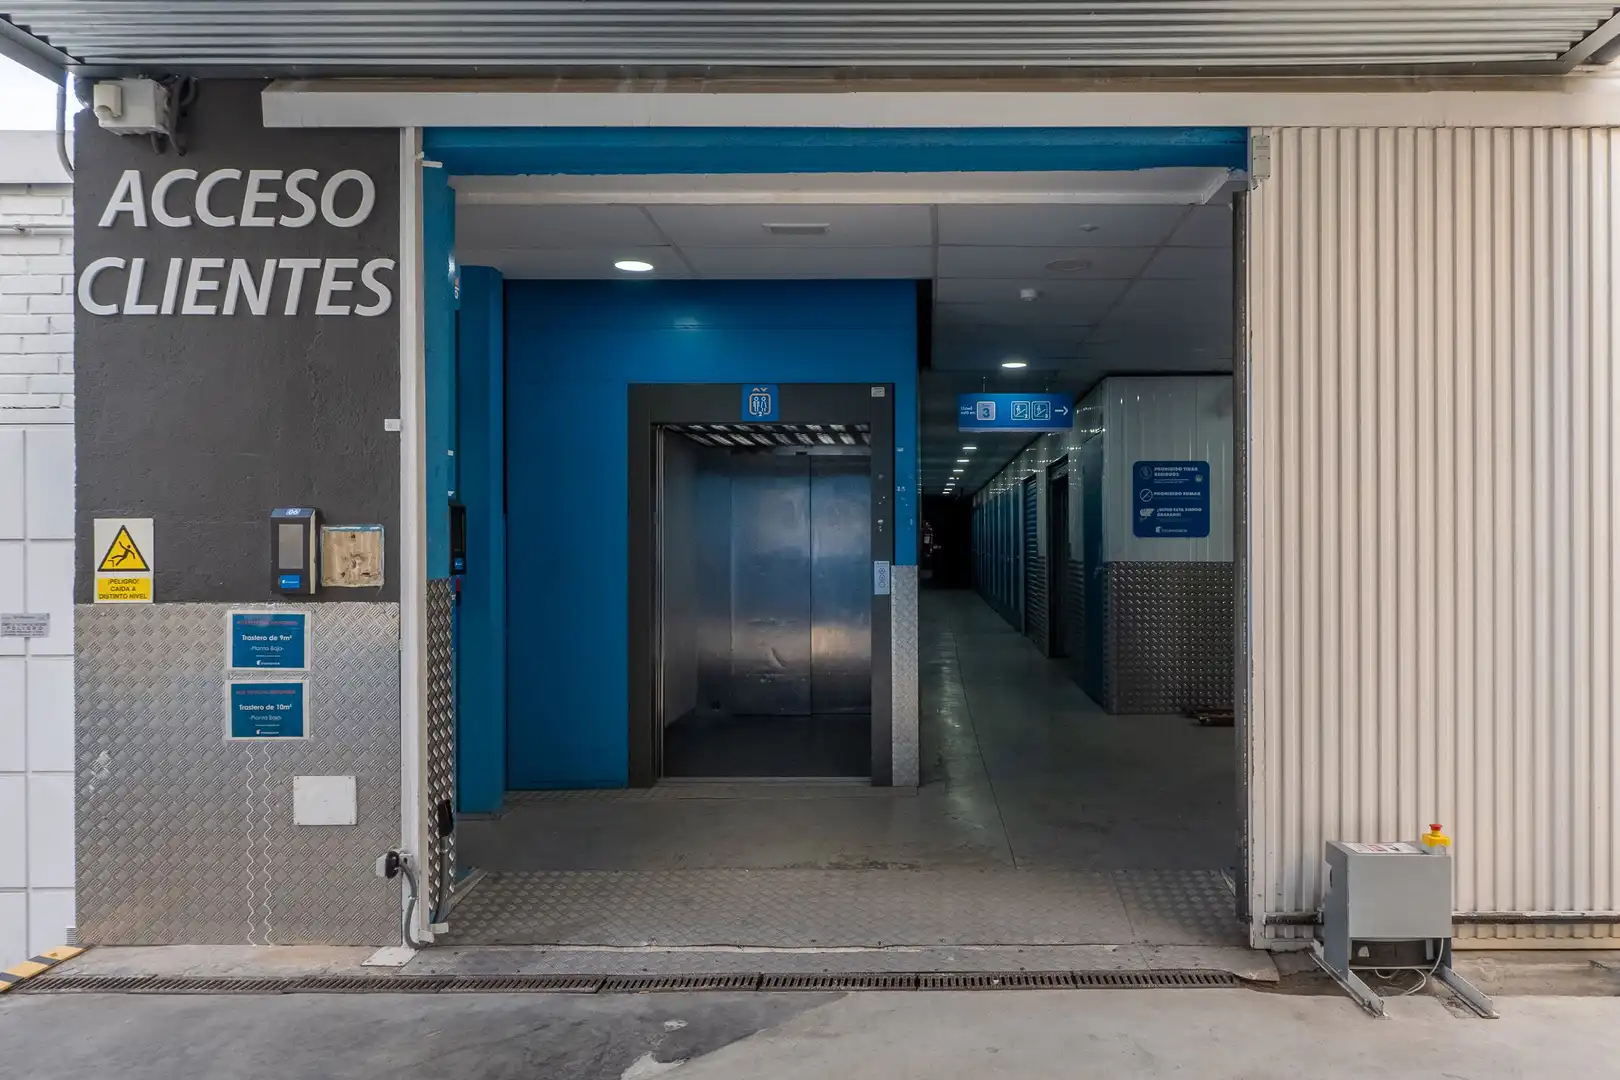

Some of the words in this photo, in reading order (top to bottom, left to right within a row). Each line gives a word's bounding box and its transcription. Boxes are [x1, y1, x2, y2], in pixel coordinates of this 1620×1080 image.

[98, 168, 376, 227] ACCESO
[77, 256, 396, 316] CLIENTES
[982, 407, 990, 418] 3
